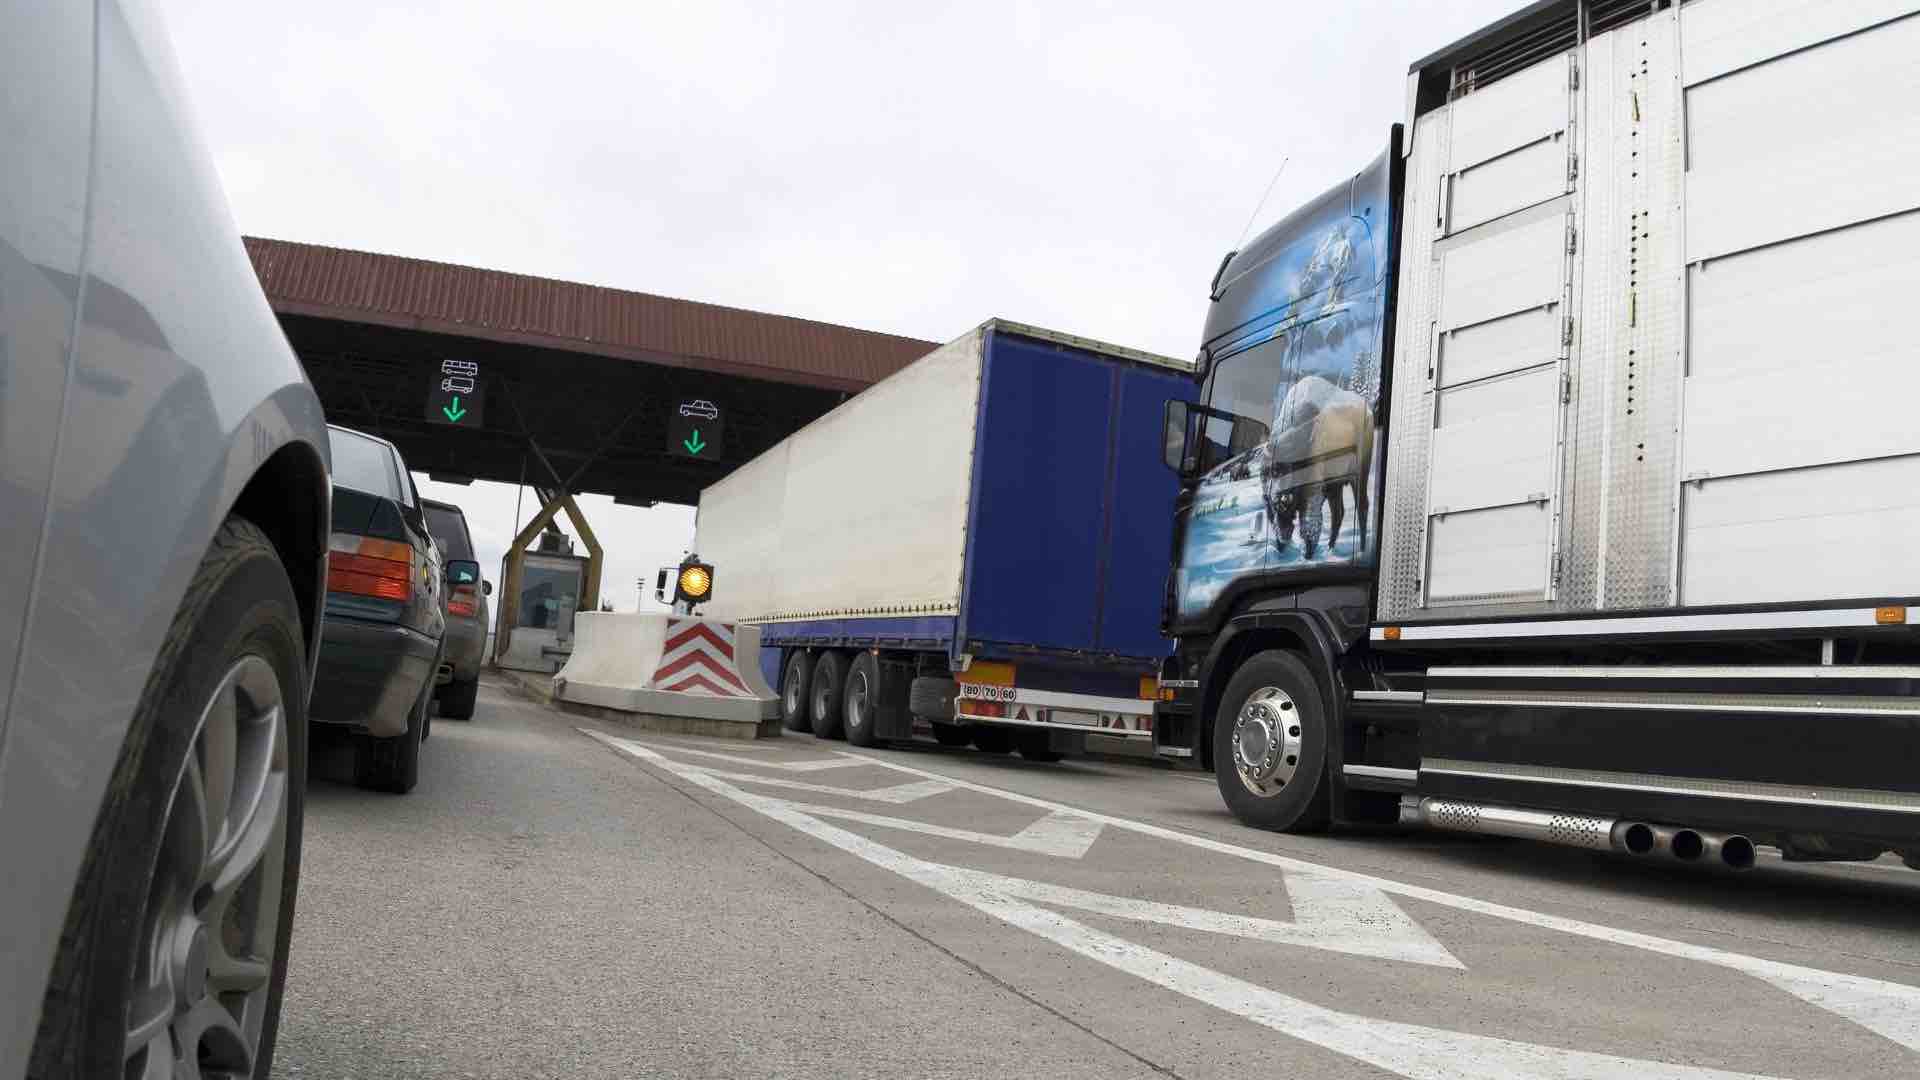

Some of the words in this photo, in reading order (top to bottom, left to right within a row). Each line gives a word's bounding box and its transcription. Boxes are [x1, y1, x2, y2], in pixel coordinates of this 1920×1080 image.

[966, 686, 979, 696] 80
[984, 687, 997, 698] 70
[1002, 689, 1015, 700] 60
